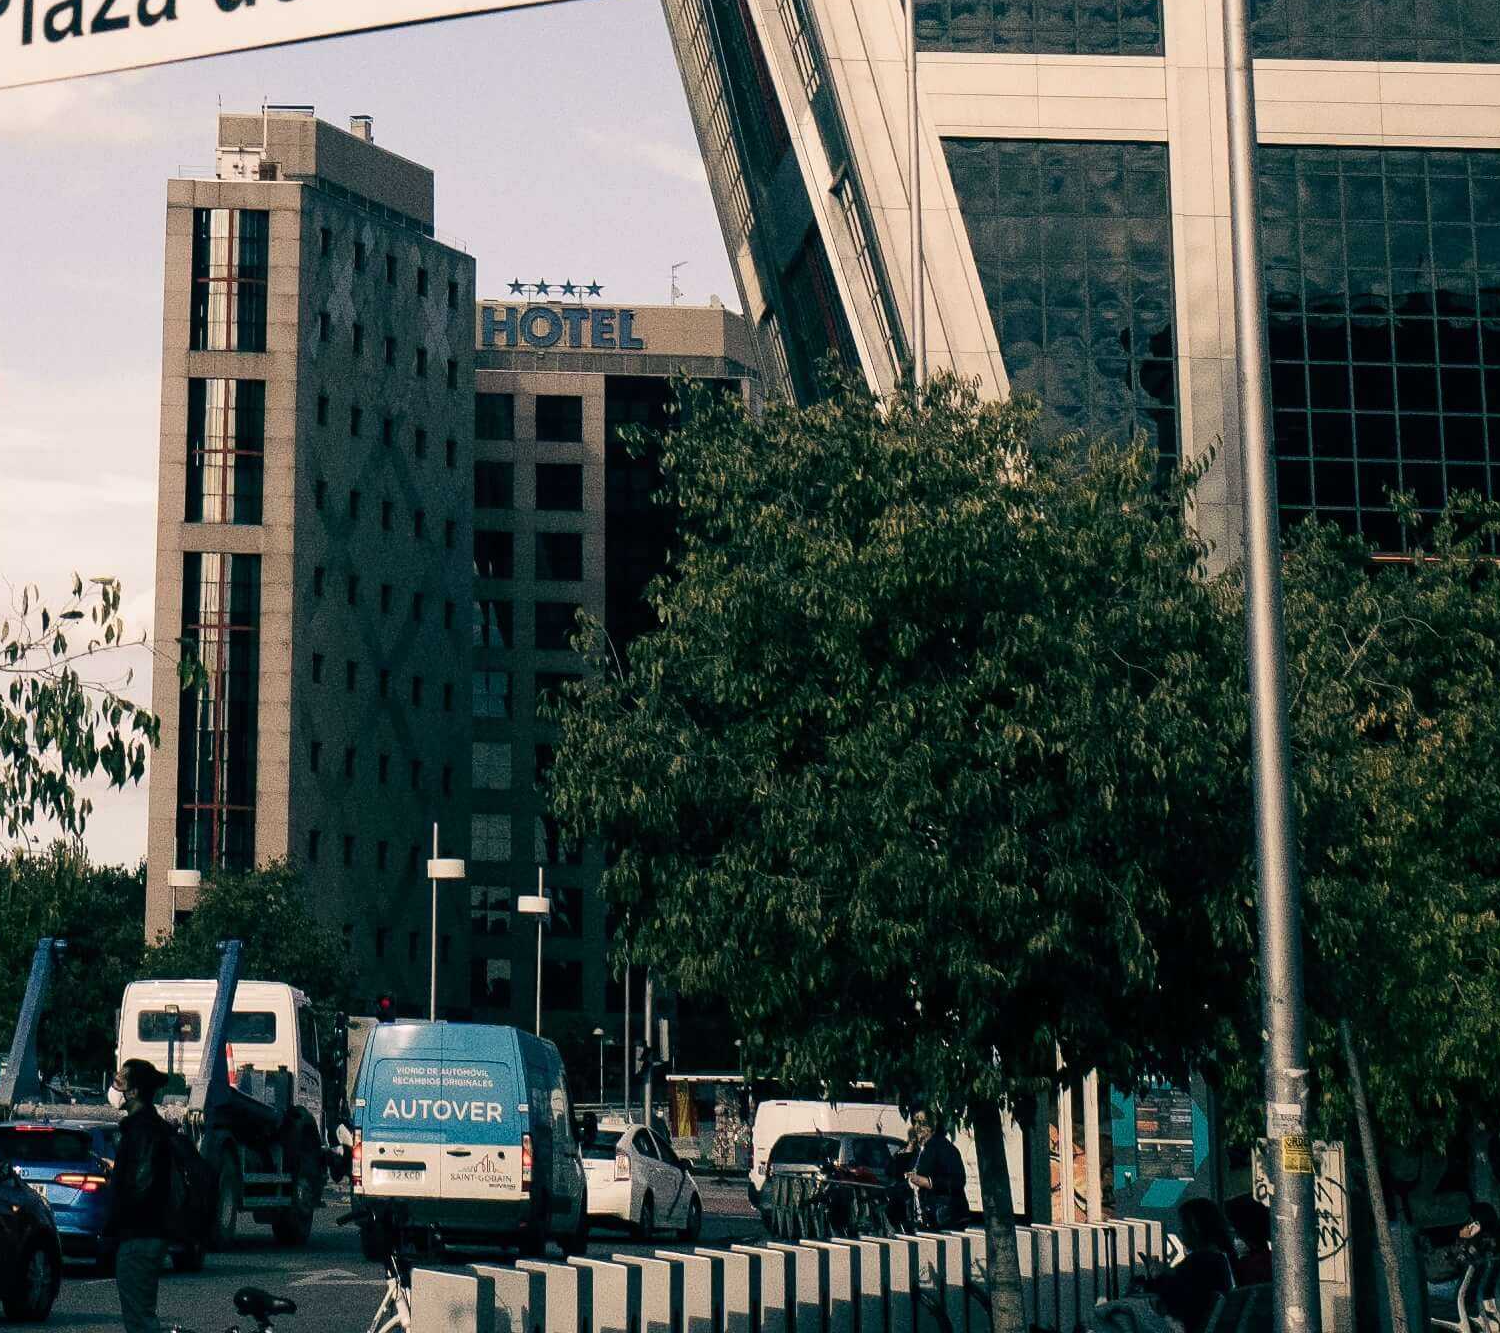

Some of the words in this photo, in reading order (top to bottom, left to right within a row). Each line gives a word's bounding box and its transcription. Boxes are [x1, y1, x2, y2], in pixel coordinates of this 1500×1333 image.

[481, 306, 645, 350] HOTEL
[382, 1098, 503, 1123] AUTOVER
[450, 1173, 512, 1183] SAINT-GOBAIN
